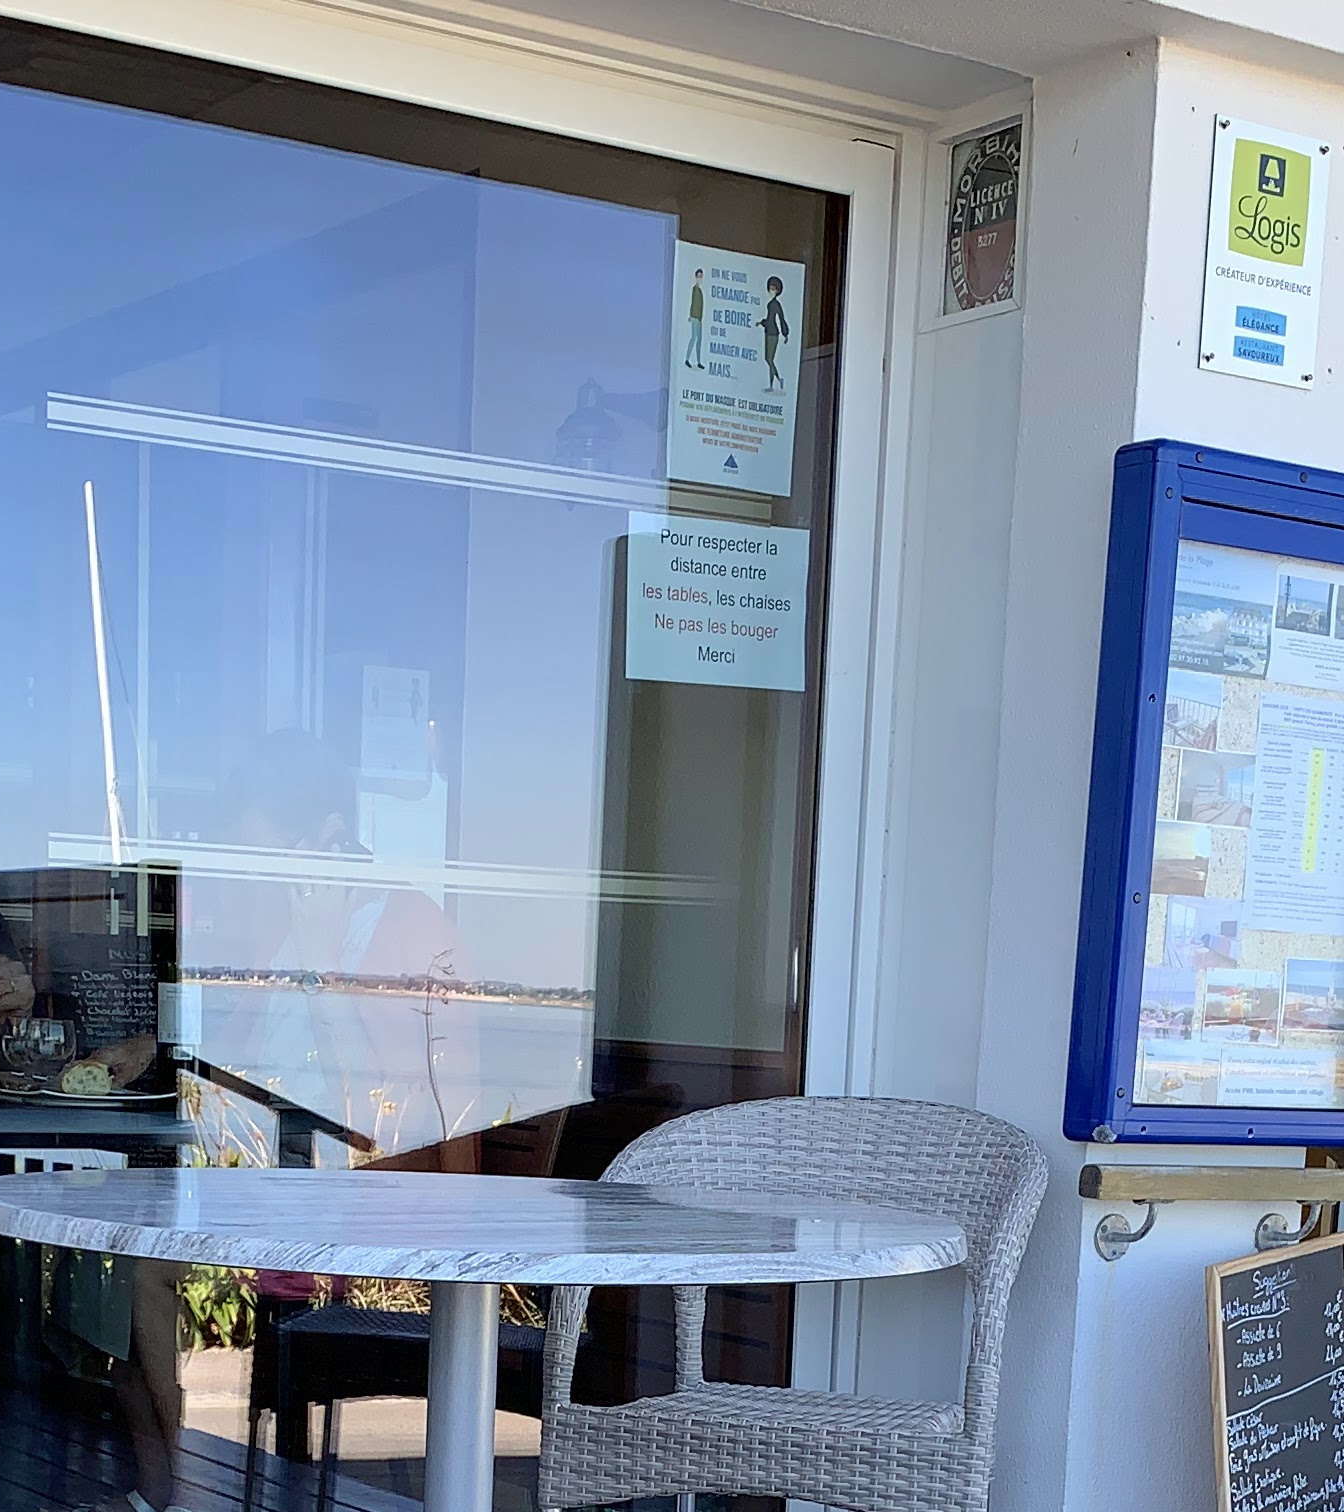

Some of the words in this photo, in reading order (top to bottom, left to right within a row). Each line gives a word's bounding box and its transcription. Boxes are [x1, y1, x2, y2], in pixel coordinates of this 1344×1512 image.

[971, 180, 1014, 208] LICENCE
[991, 199, 1008, 222] IV
[1234, 195, 1301, 255] Logis
[950, 236, 970, 299] DEBIT
[1216, 265, 1256, 285] CRÉATEUR
[711, 285, 749, 304] DEMANDE
[713, 309, 723, 323] DE
[724, 308, 752, 329] BOIRE
[1242, 315, 1280, 335] ÉLÉGANCE
[709, 341, 740, 360] MANGER
[741, 346, 758, 362] AVEC
[1238, 347, 1280, 364] SAVOUREUX
[682, 389, 690, 400] LE
[690, 390, 704, 402] PORT
[705, 392, 714, 404] DU
[715, 394, 736, 408] MASQUE
[738, 399, 749, 409] EST
[749, 401, 784, 417] OBLIGATOIRE
[660, 529, 694, 547] Pour
[697, 534, 762, 554] respecter
[765, 540, 778, 556] la
[670, 557, 727, 577] distance
[731, 564, 767, 581] entre
[642, 583, 663, 600] les
[667, 585, 712, 607] tables,
[716, 590, 735, 607] les
[739, 593, 791, 612] chaises
[654, 613, 674, 630] Ne
[678, 618, 703, 635] pas
[708, 618, 727, 635] les
[731, 621, 779, 642] bouger
[698, 645, 736, 664] Merci
[1267, 1324, 1275, 1340] de
[1267, 1346, 1275, 1361] de
